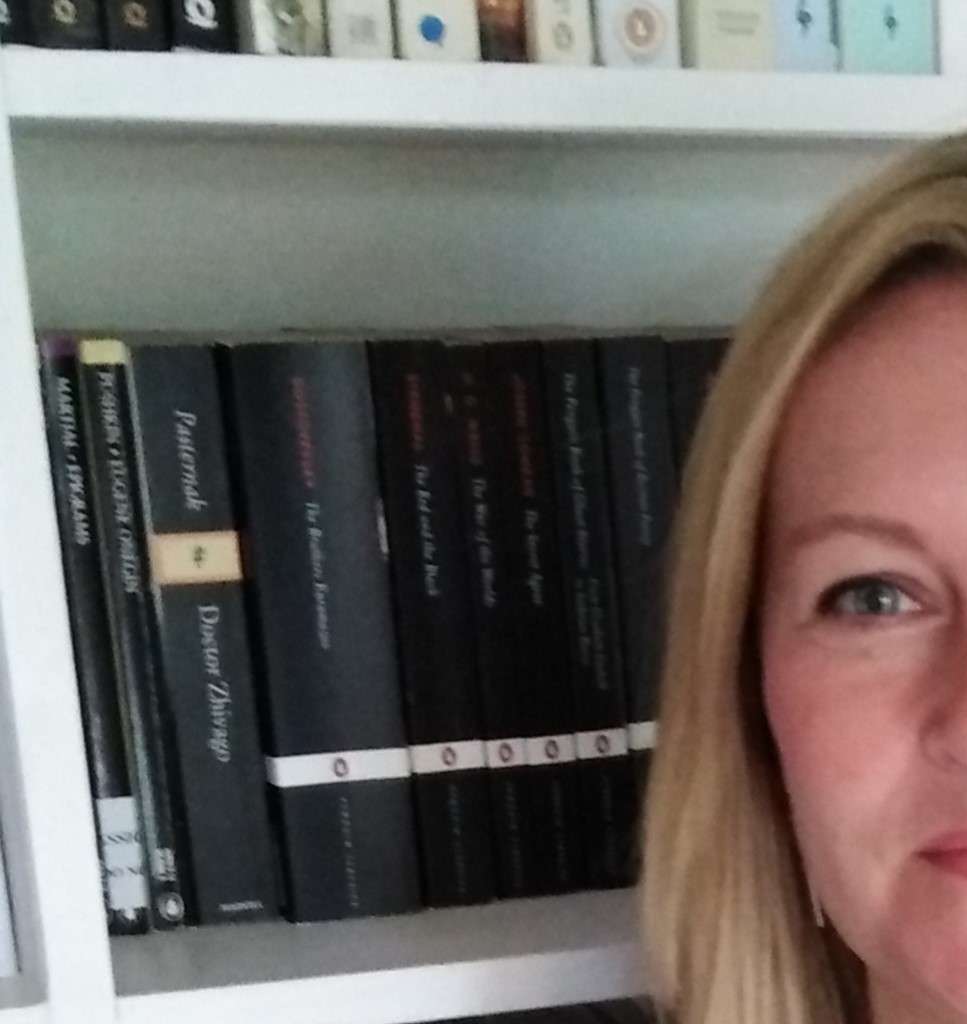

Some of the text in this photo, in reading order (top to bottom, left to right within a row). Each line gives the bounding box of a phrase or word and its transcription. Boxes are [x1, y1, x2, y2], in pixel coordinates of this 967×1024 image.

[173, 409, 208, 511] Pasternak
[197, 604, 233, 763] Doctor Zhivago
